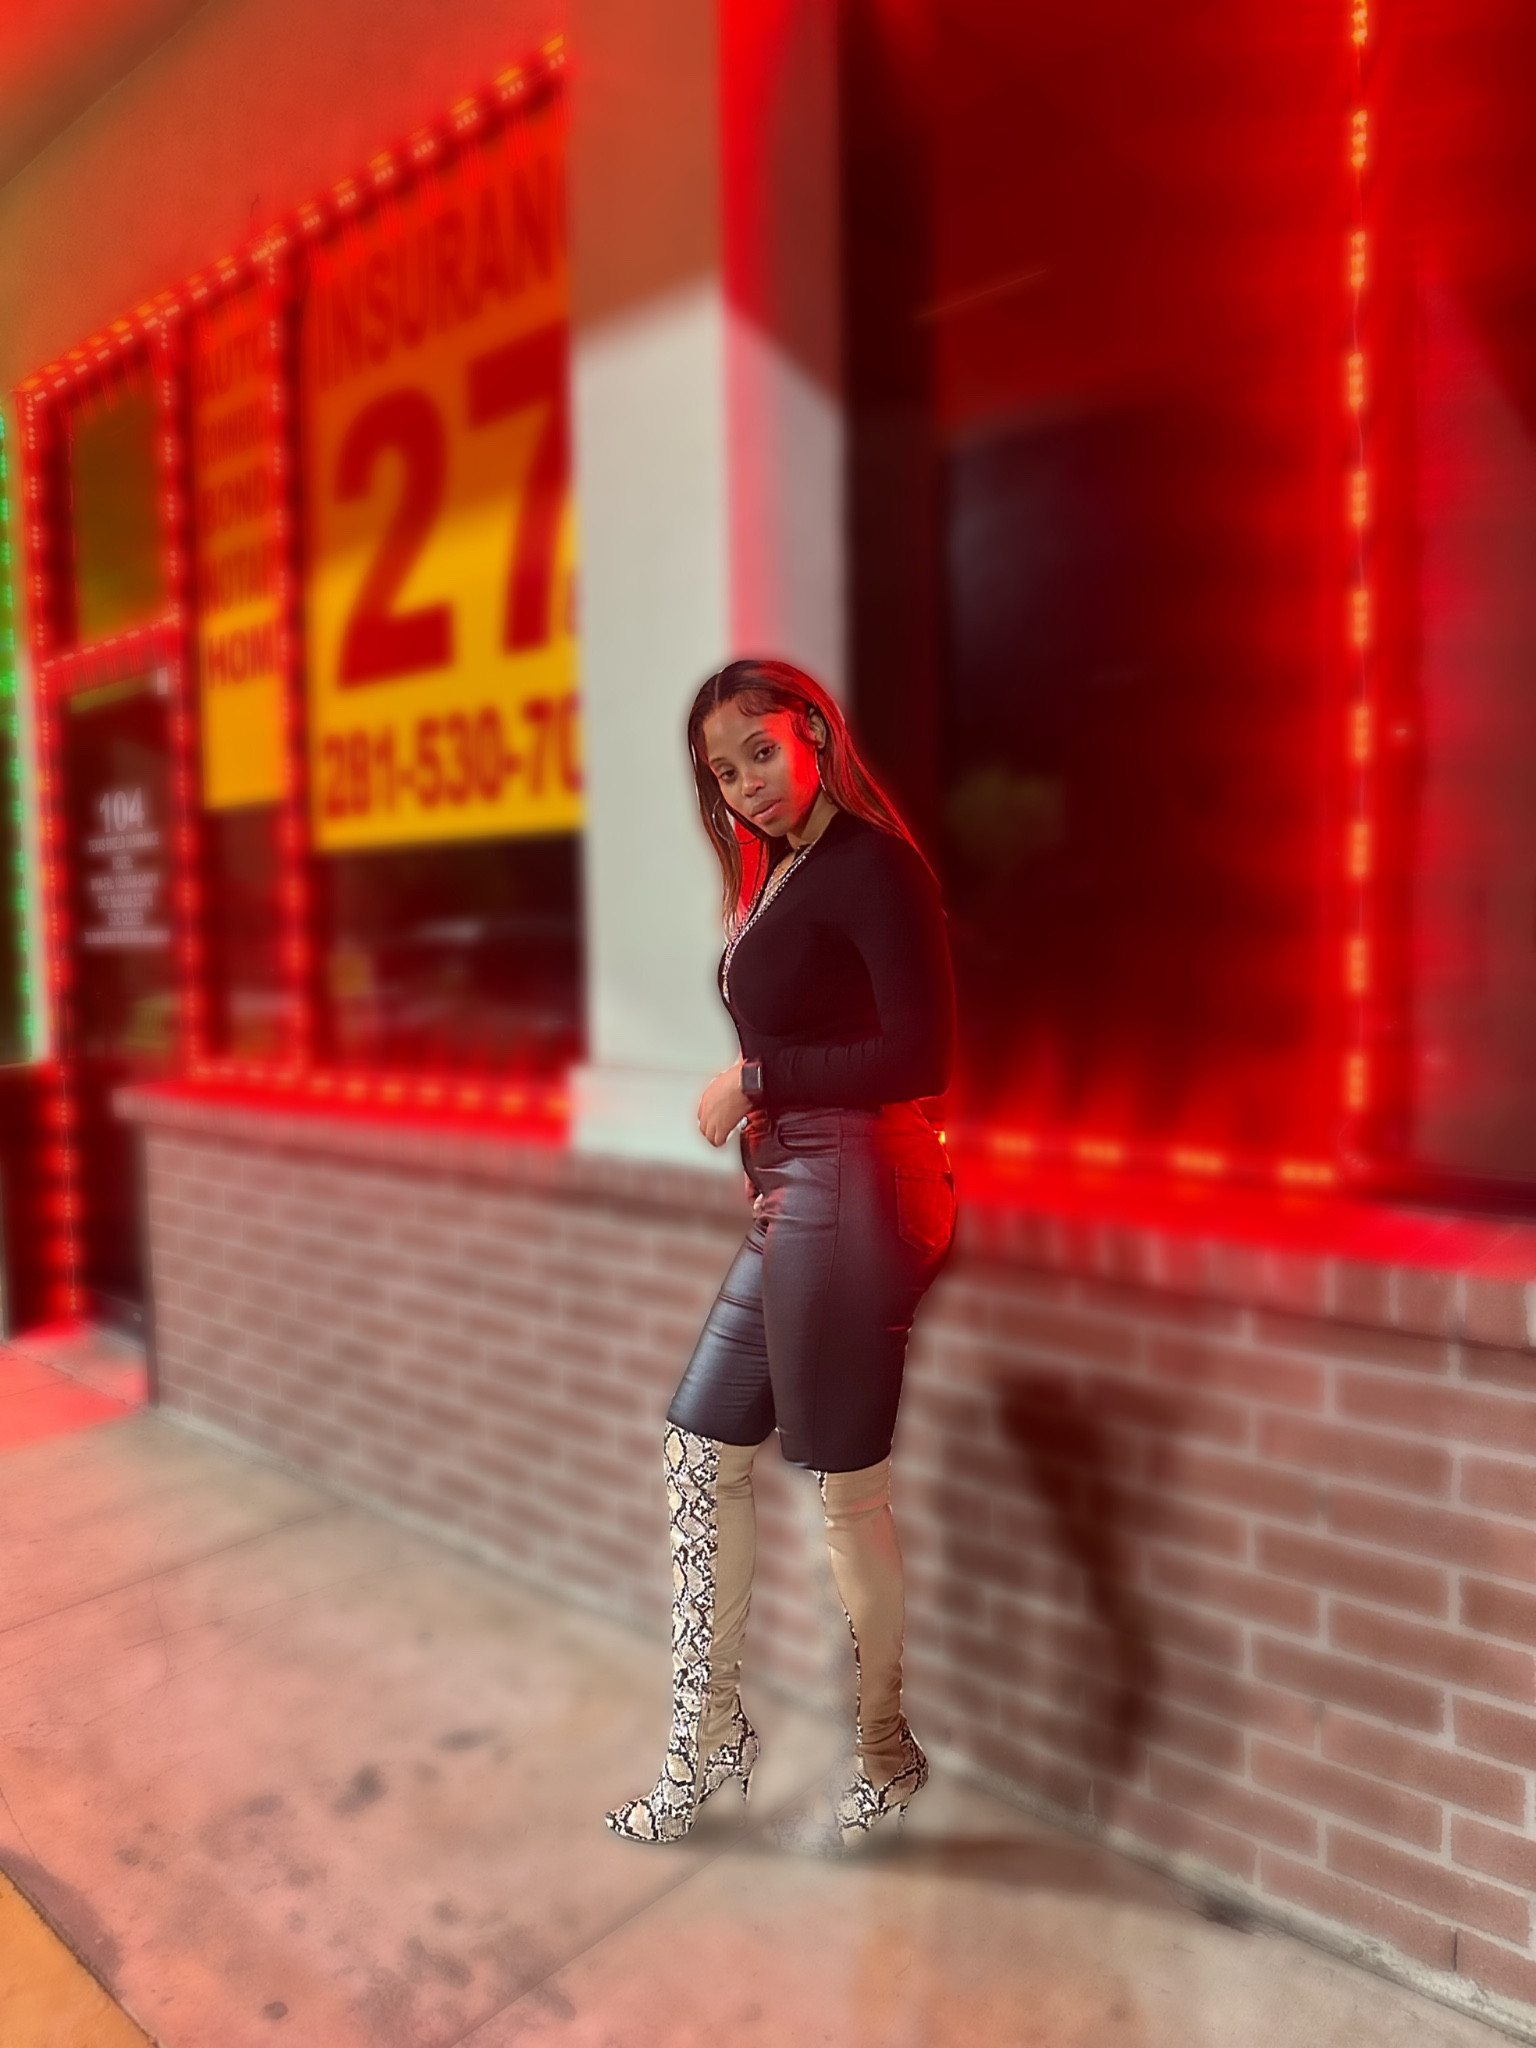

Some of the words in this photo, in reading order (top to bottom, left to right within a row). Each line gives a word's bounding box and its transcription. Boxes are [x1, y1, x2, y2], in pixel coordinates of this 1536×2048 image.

[316, 153, 567, 391] INSURAN
[201, 397, 273, 468] COMMERCI
[99, 787, 145, 833] 104
